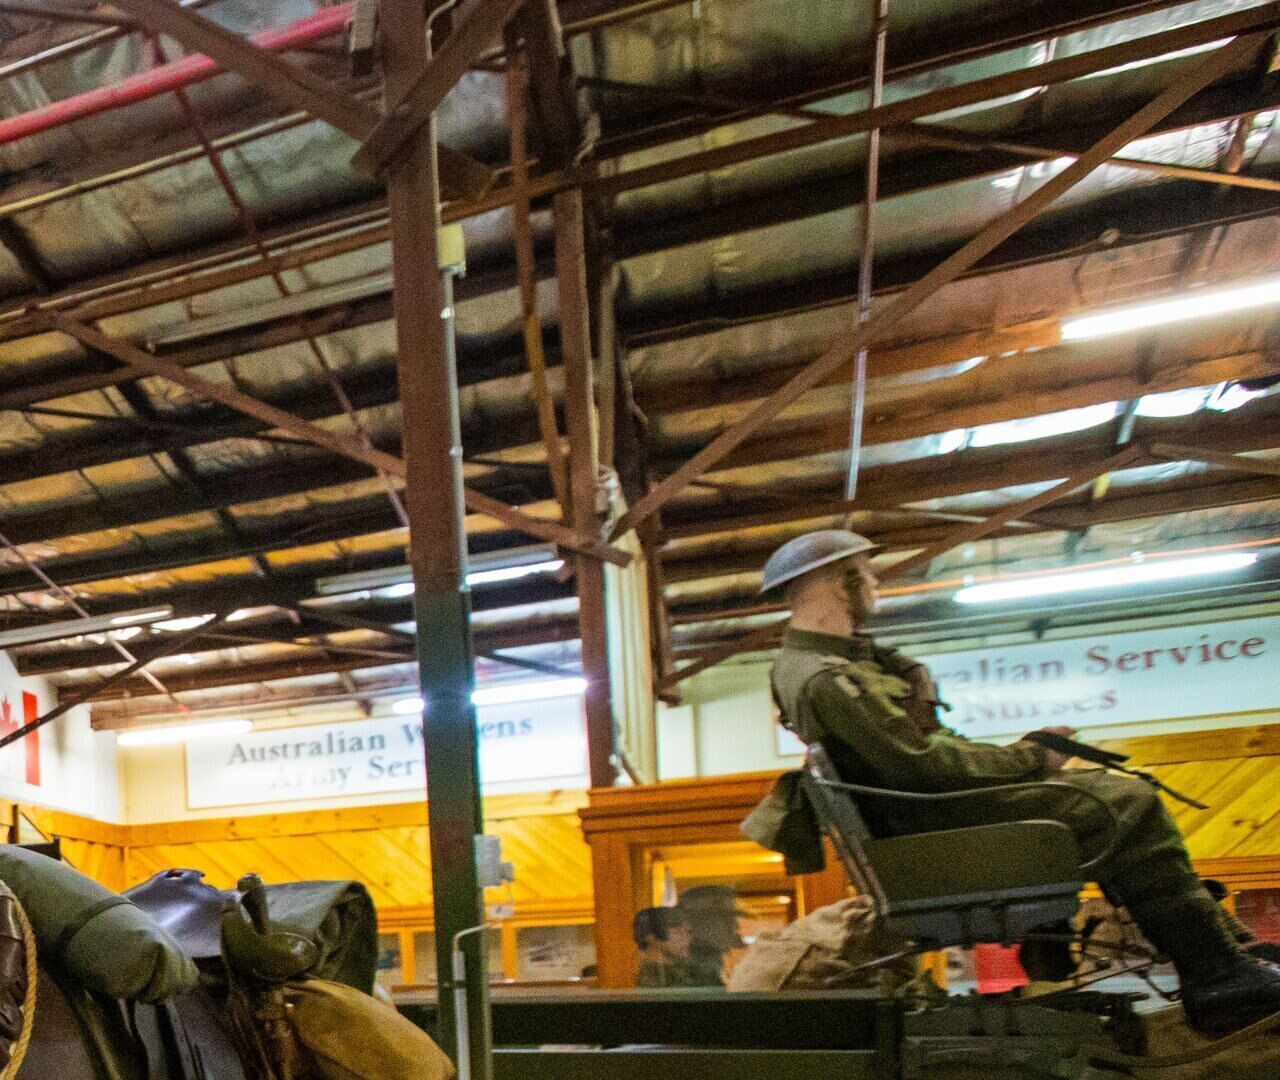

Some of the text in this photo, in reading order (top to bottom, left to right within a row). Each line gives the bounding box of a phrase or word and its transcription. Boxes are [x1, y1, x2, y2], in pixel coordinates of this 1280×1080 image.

[1086, 632, 1267, 677] Service
[961, 688, 1120, 726] Nurses
[226, 729, 387, 767] Australian
[269, 762, 353, 793] Army
